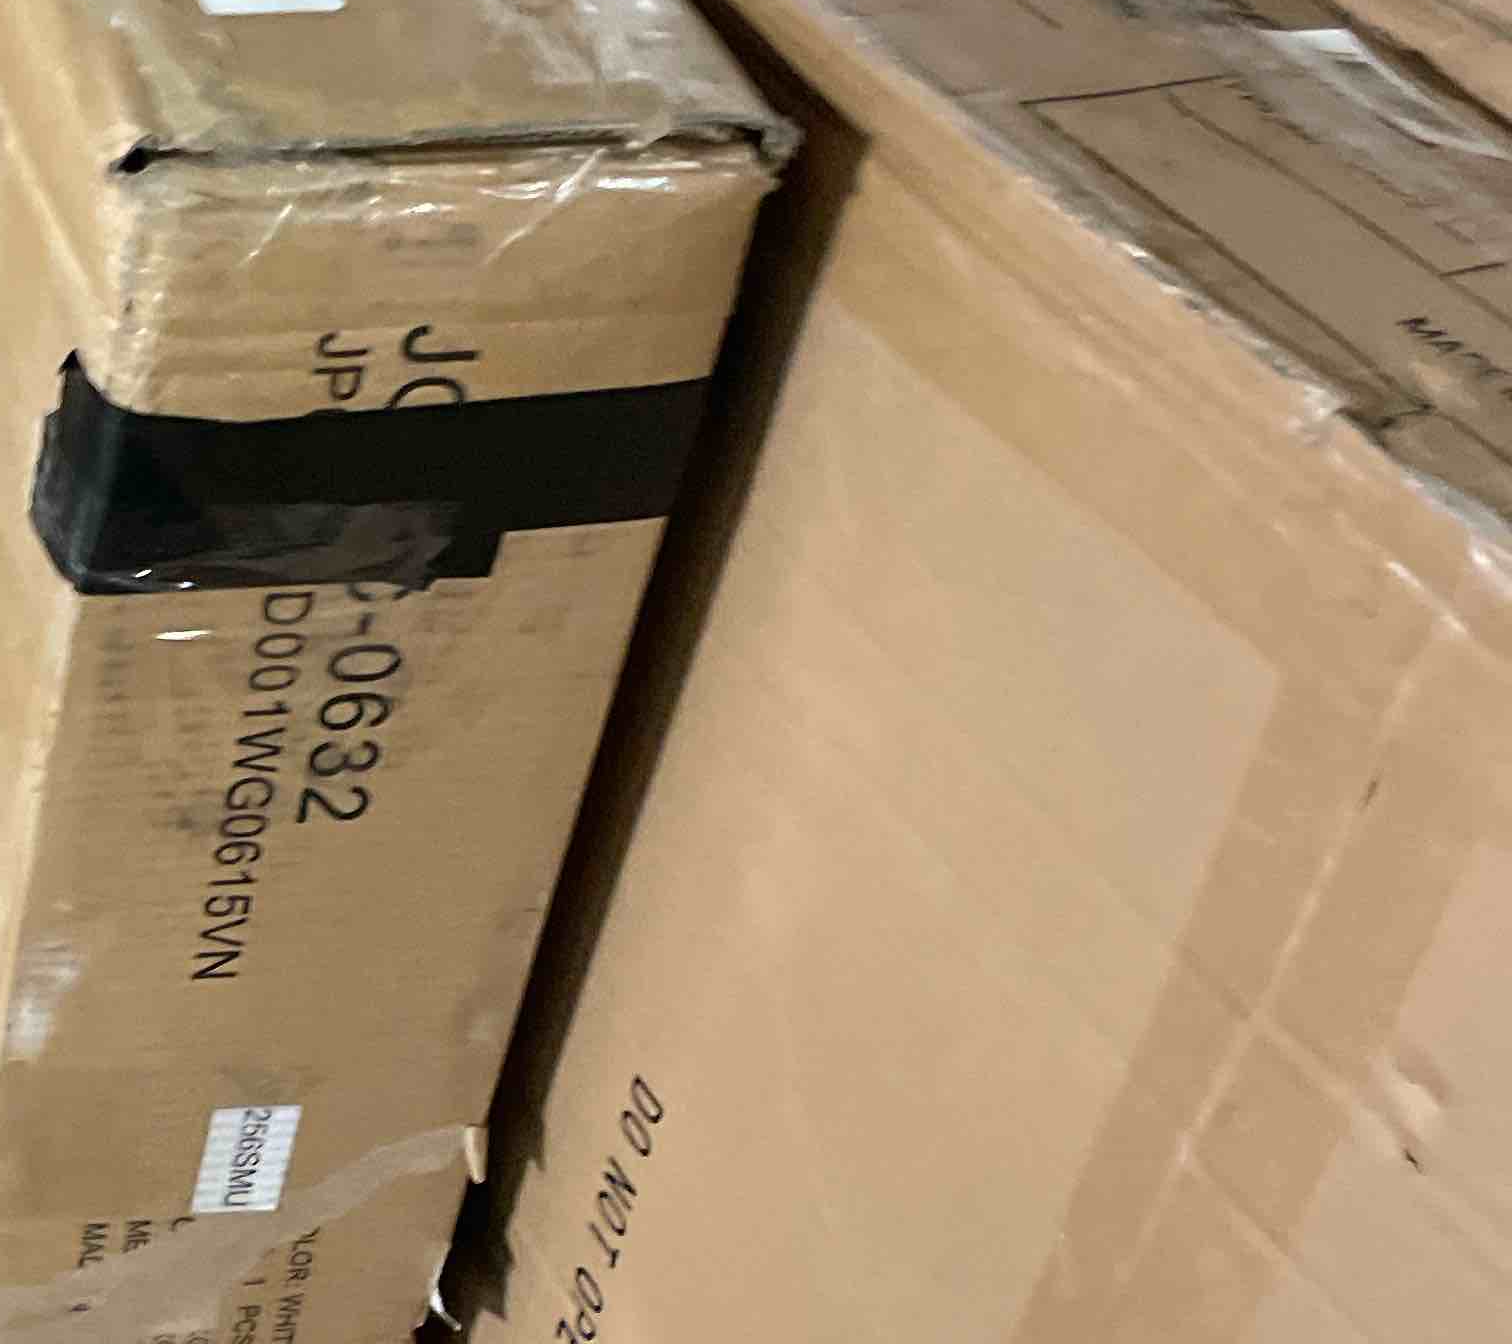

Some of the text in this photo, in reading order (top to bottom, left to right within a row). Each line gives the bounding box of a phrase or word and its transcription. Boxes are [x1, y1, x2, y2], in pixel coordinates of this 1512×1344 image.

[191, 330, 371, 982] JP D001WG0615VN
[619, 1074, 665, 1158] DO
[588, 1156, 639, 1269] NOT
